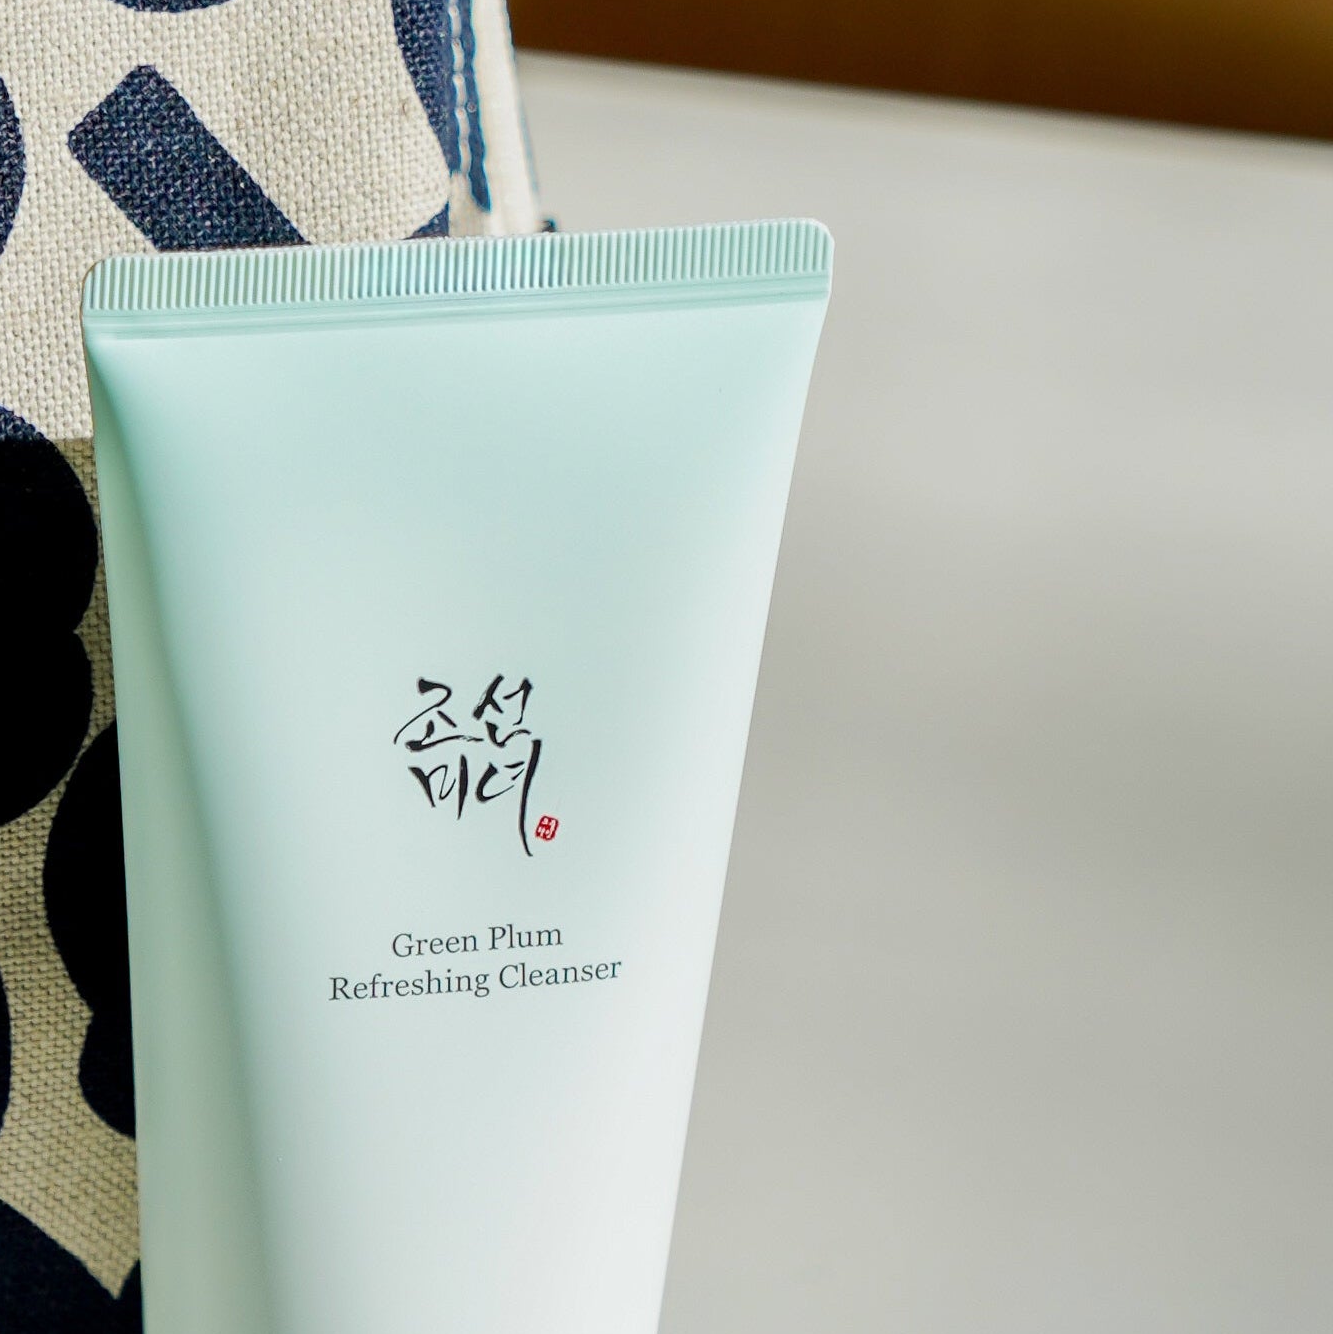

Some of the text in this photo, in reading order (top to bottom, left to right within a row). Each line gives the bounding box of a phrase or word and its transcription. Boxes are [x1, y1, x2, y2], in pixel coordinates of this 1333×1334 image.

[393, 673, 534, 753] 조선
[407, 738, 543, 857] 미녀
[391, 923, 564, 958] Green Plum
[328, 958, 623, 1002] Refreshing Cleanser
